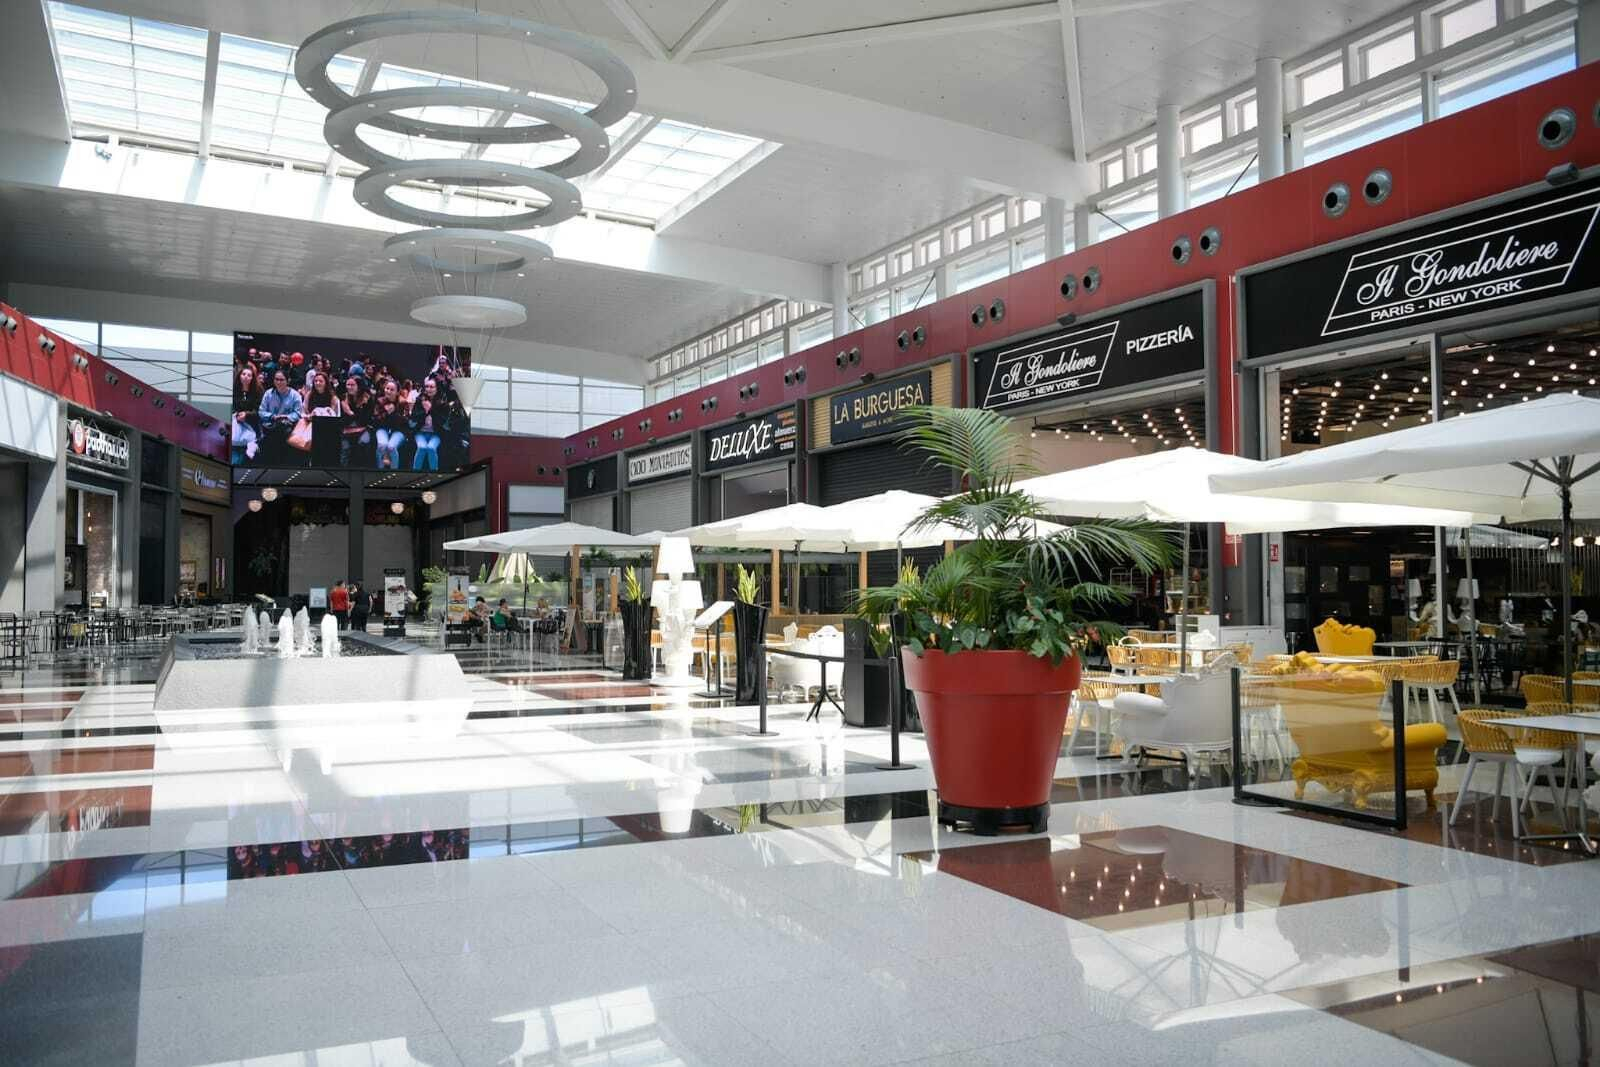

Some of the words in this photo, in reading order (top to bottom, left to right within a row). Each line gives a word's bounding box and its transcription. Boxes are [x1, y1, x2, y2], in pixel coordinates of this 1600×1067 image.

[1356, 264, 1399, 305] Il
[1404, 235, 1559, 298] Gondoliere
[1370, 302, 1415, 321] PARIS
[1428, 289, 1468, 309] NEW
[1469, 278, 1523, 300] YORK
[1126, 325, 1194, 354] PIZZERÍA
[1000, 363, 1021, 390] Il
[1024, 347, 1097, 387] Gondoliere
[834, 402, 850, 425] LA
[853, 383, 925, 421] BURGUESA
[1007, 389, 1031, 402] PARIS
[1035, 383, 1056, 397] NEW
[1056, 378, 1080, 392] YORK
[709, 419, 773, 461] DELUXE
